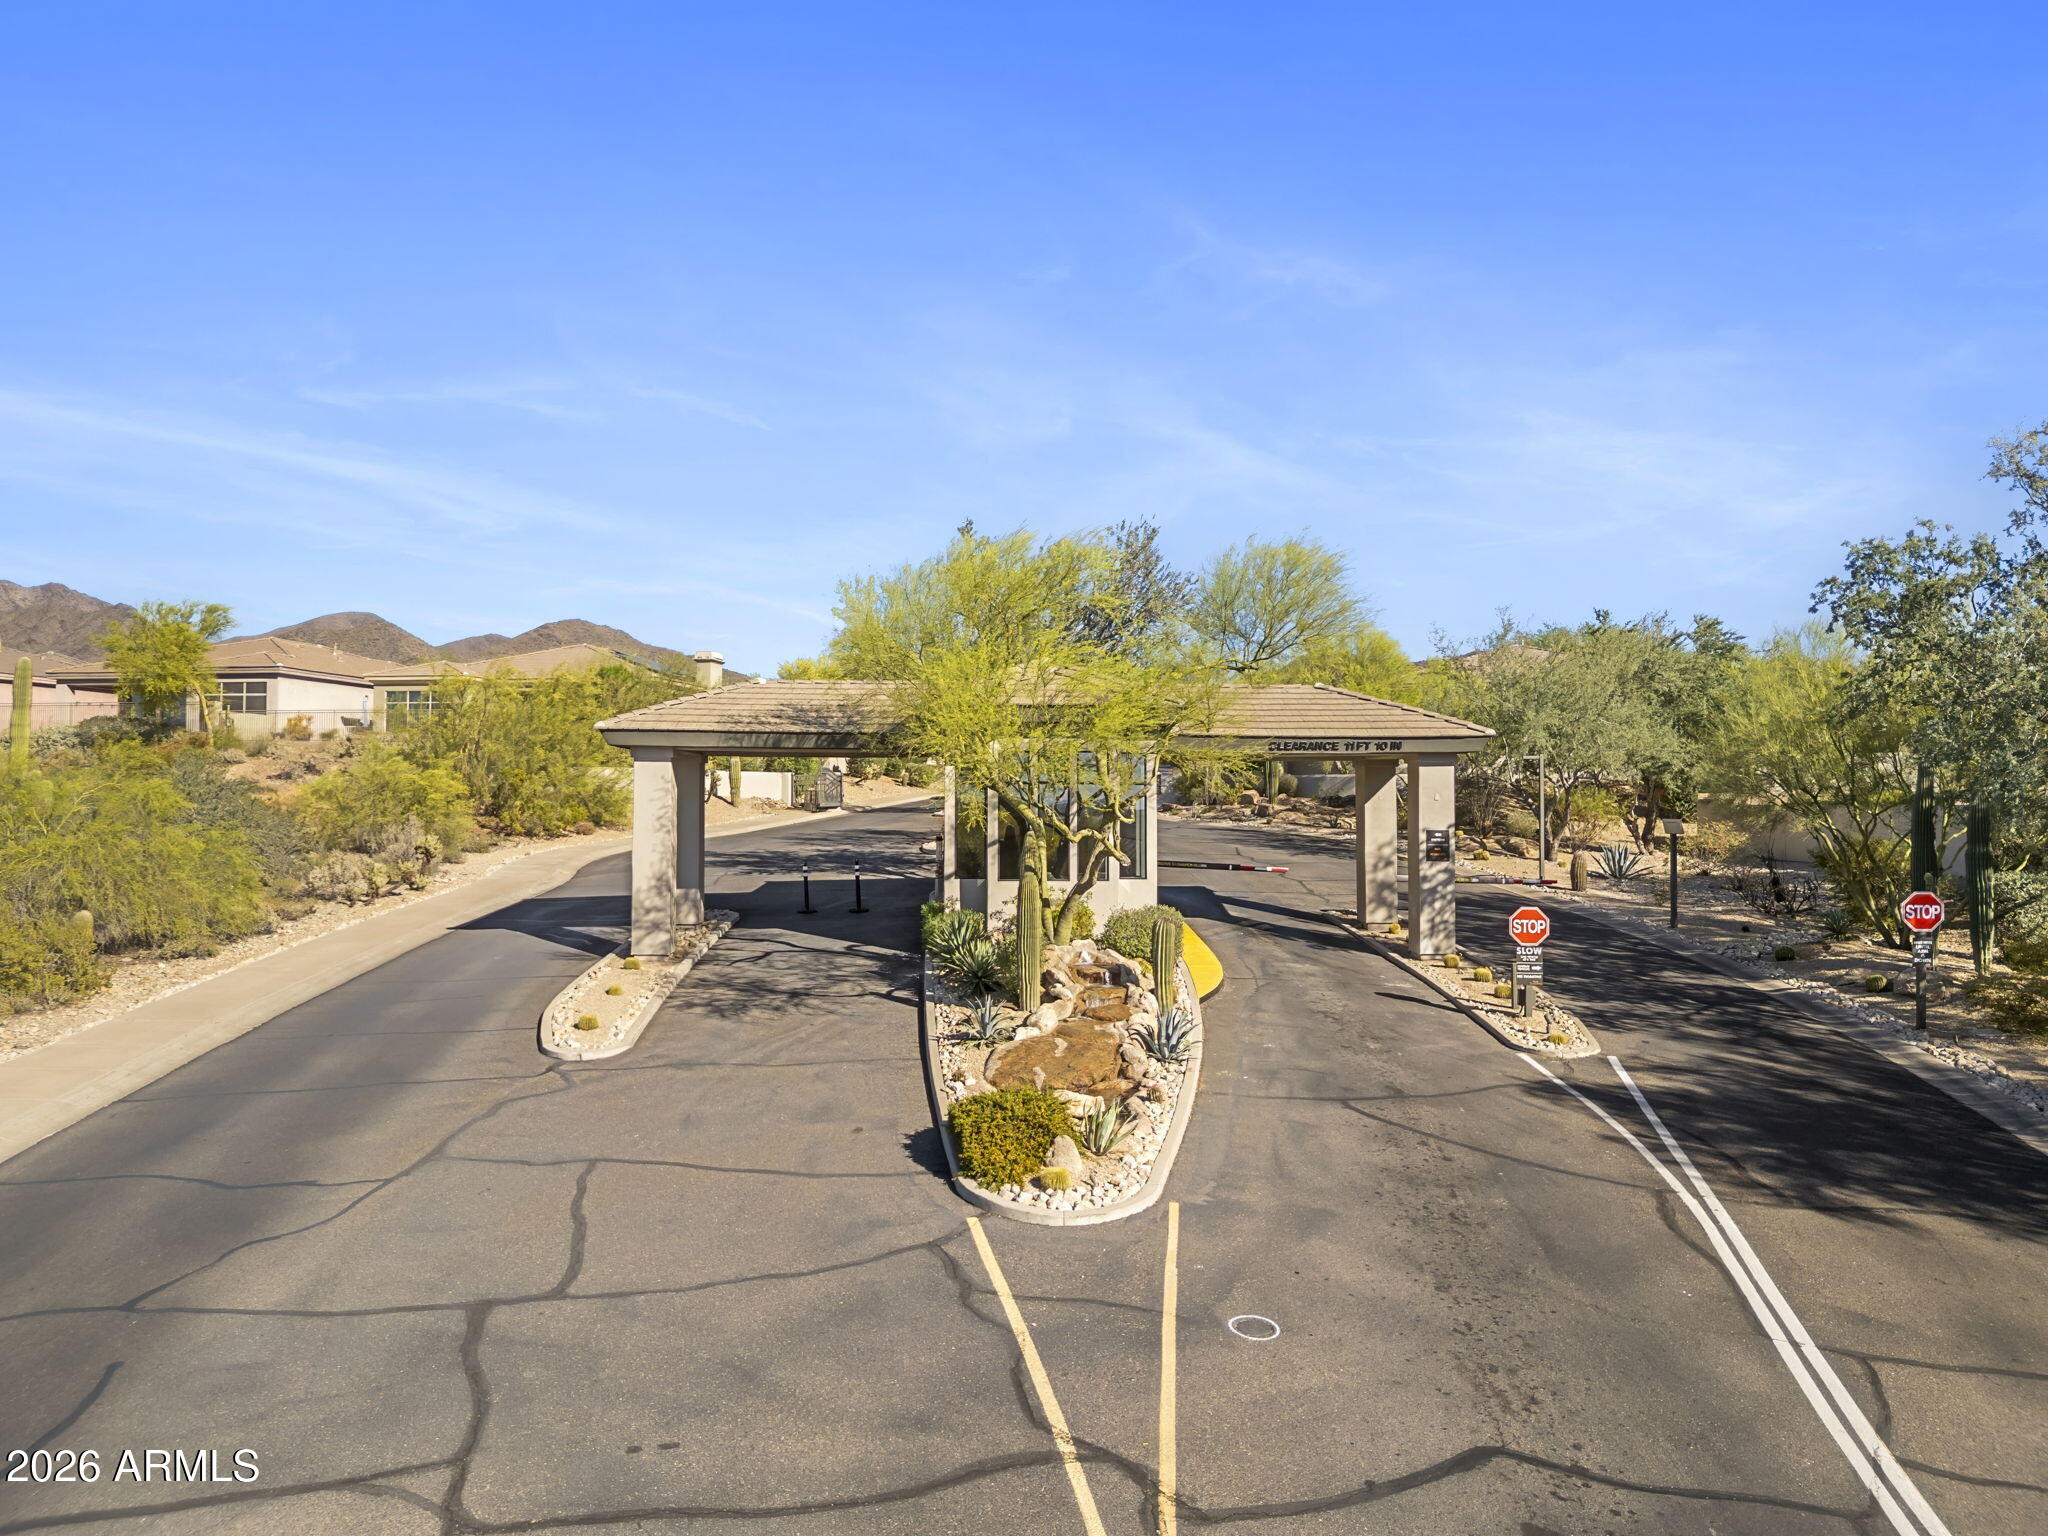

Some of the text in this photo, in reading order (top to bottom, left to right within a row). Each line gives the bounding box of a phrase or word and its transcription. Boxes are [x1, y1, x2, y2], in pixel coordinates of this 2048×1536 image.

[1268, 741, 1339, 751] CLEARANCE
[1356, 741, 1371, 751] FT
[1374, 741, 1388, 751] 10
[1390, 741, 1402, 751] IN
[1905, 904, 1941, 919] STOP
[1513, 919, 1546, 934] STOP
[1516, 947, 1542, 955] SLOW
